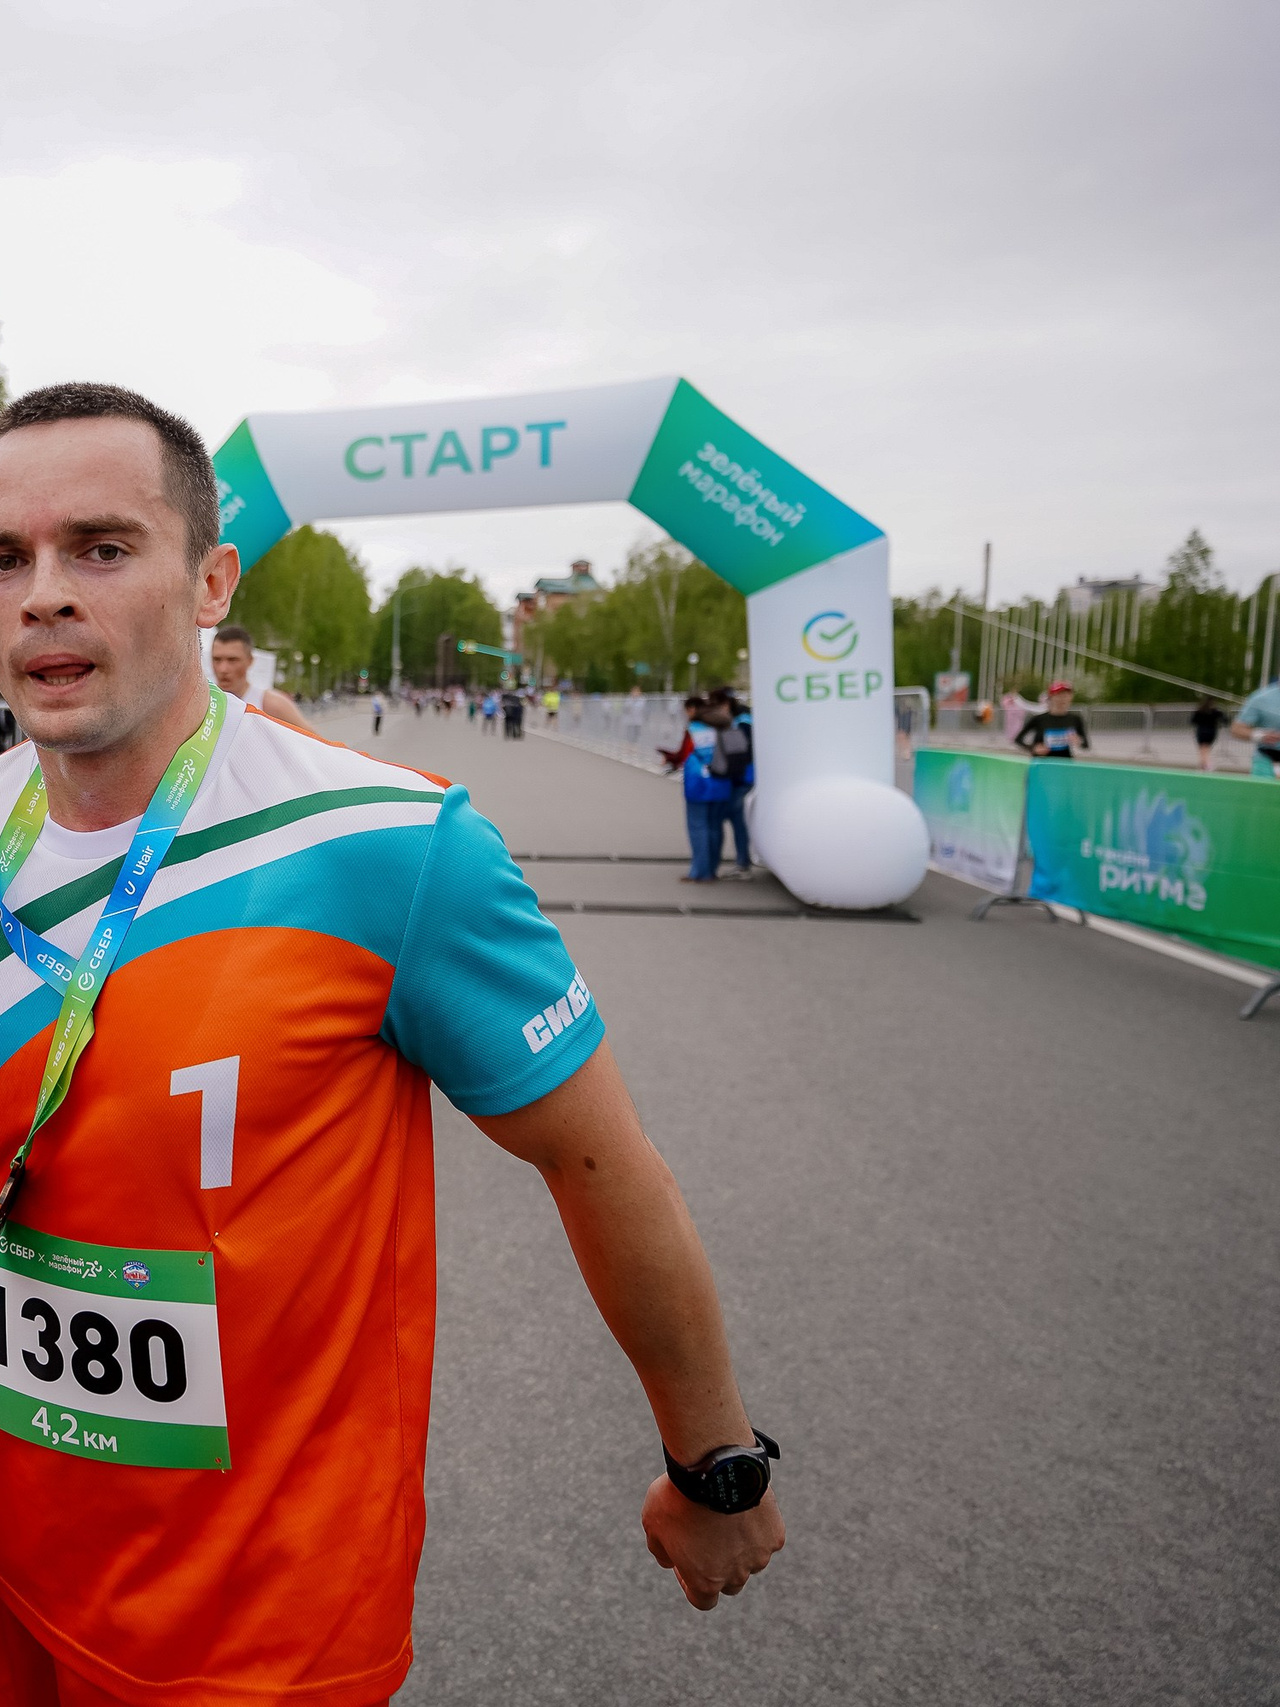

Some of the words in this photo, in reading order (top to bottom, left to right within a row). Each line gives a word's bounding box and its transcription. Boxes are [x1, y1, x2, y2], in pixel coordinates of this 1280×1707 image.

[344, 421, 567, 482] СТАРТ
[678, 460, 785, 547] марафон
[776, 671, 883, 703] СБЕР
[201, 718, 214, 741] 185
[210, 696, 218, 717] лет
[170, 779, 189, 810] марафон
[133, 845, 155, 875] Utair
[90, 928, 114, 969] СБЕР
[36, 952, 73, 982] СБЕР
[53, 1041, 66, 1067] 185
[64, 1009, 76, 1038] лет
[169, 1054, 240, 1190] 1
[9, 1242, 35, 1260] СБЕР
[51, 1253, 84, 1267] зелёный
[49, 1261, 82, 1275] марафон
